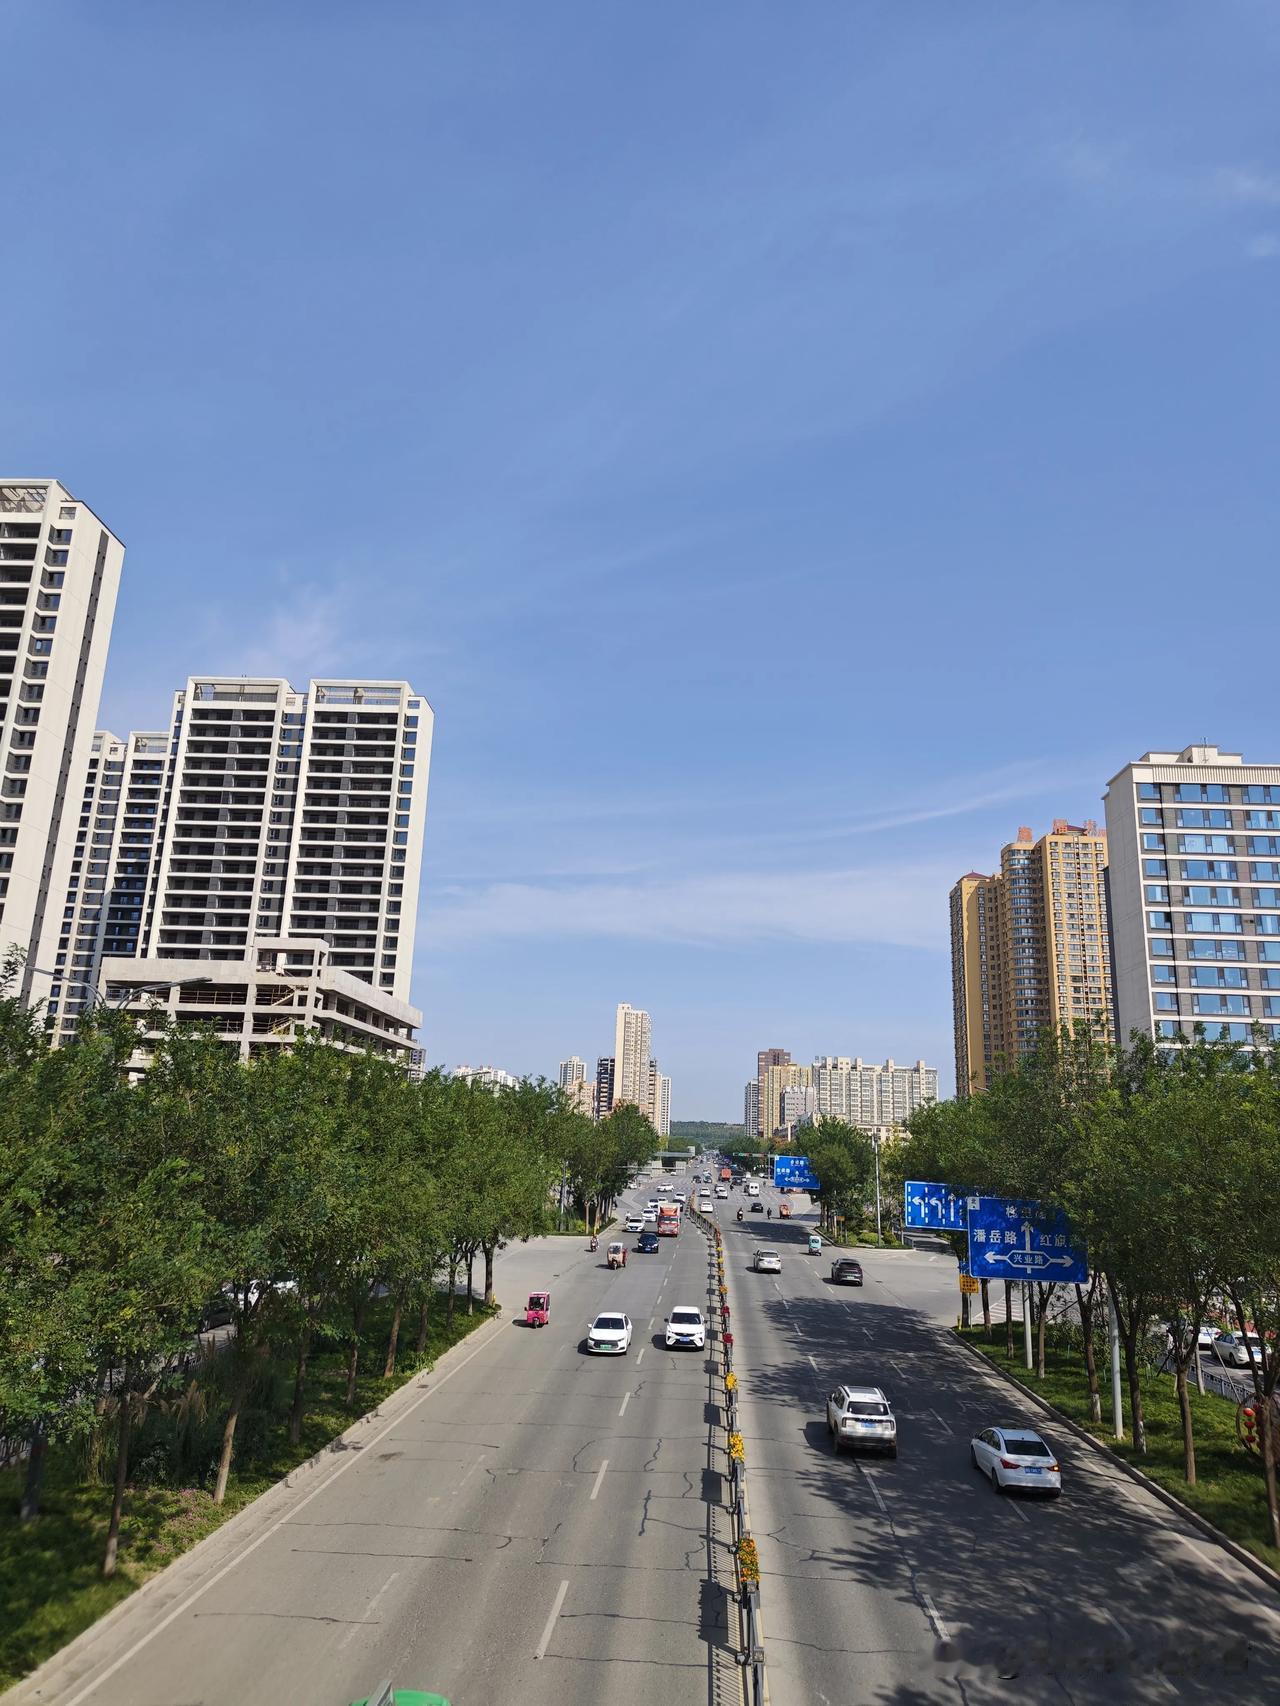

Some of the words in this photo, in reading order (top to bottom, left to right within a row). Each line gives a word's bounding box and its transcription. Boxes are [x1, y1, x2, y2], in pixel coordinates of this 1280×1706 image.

[973, 1228, 1018, 1245] 潘岳路
[1013, 1253, 1043, 1265] 兴业路
